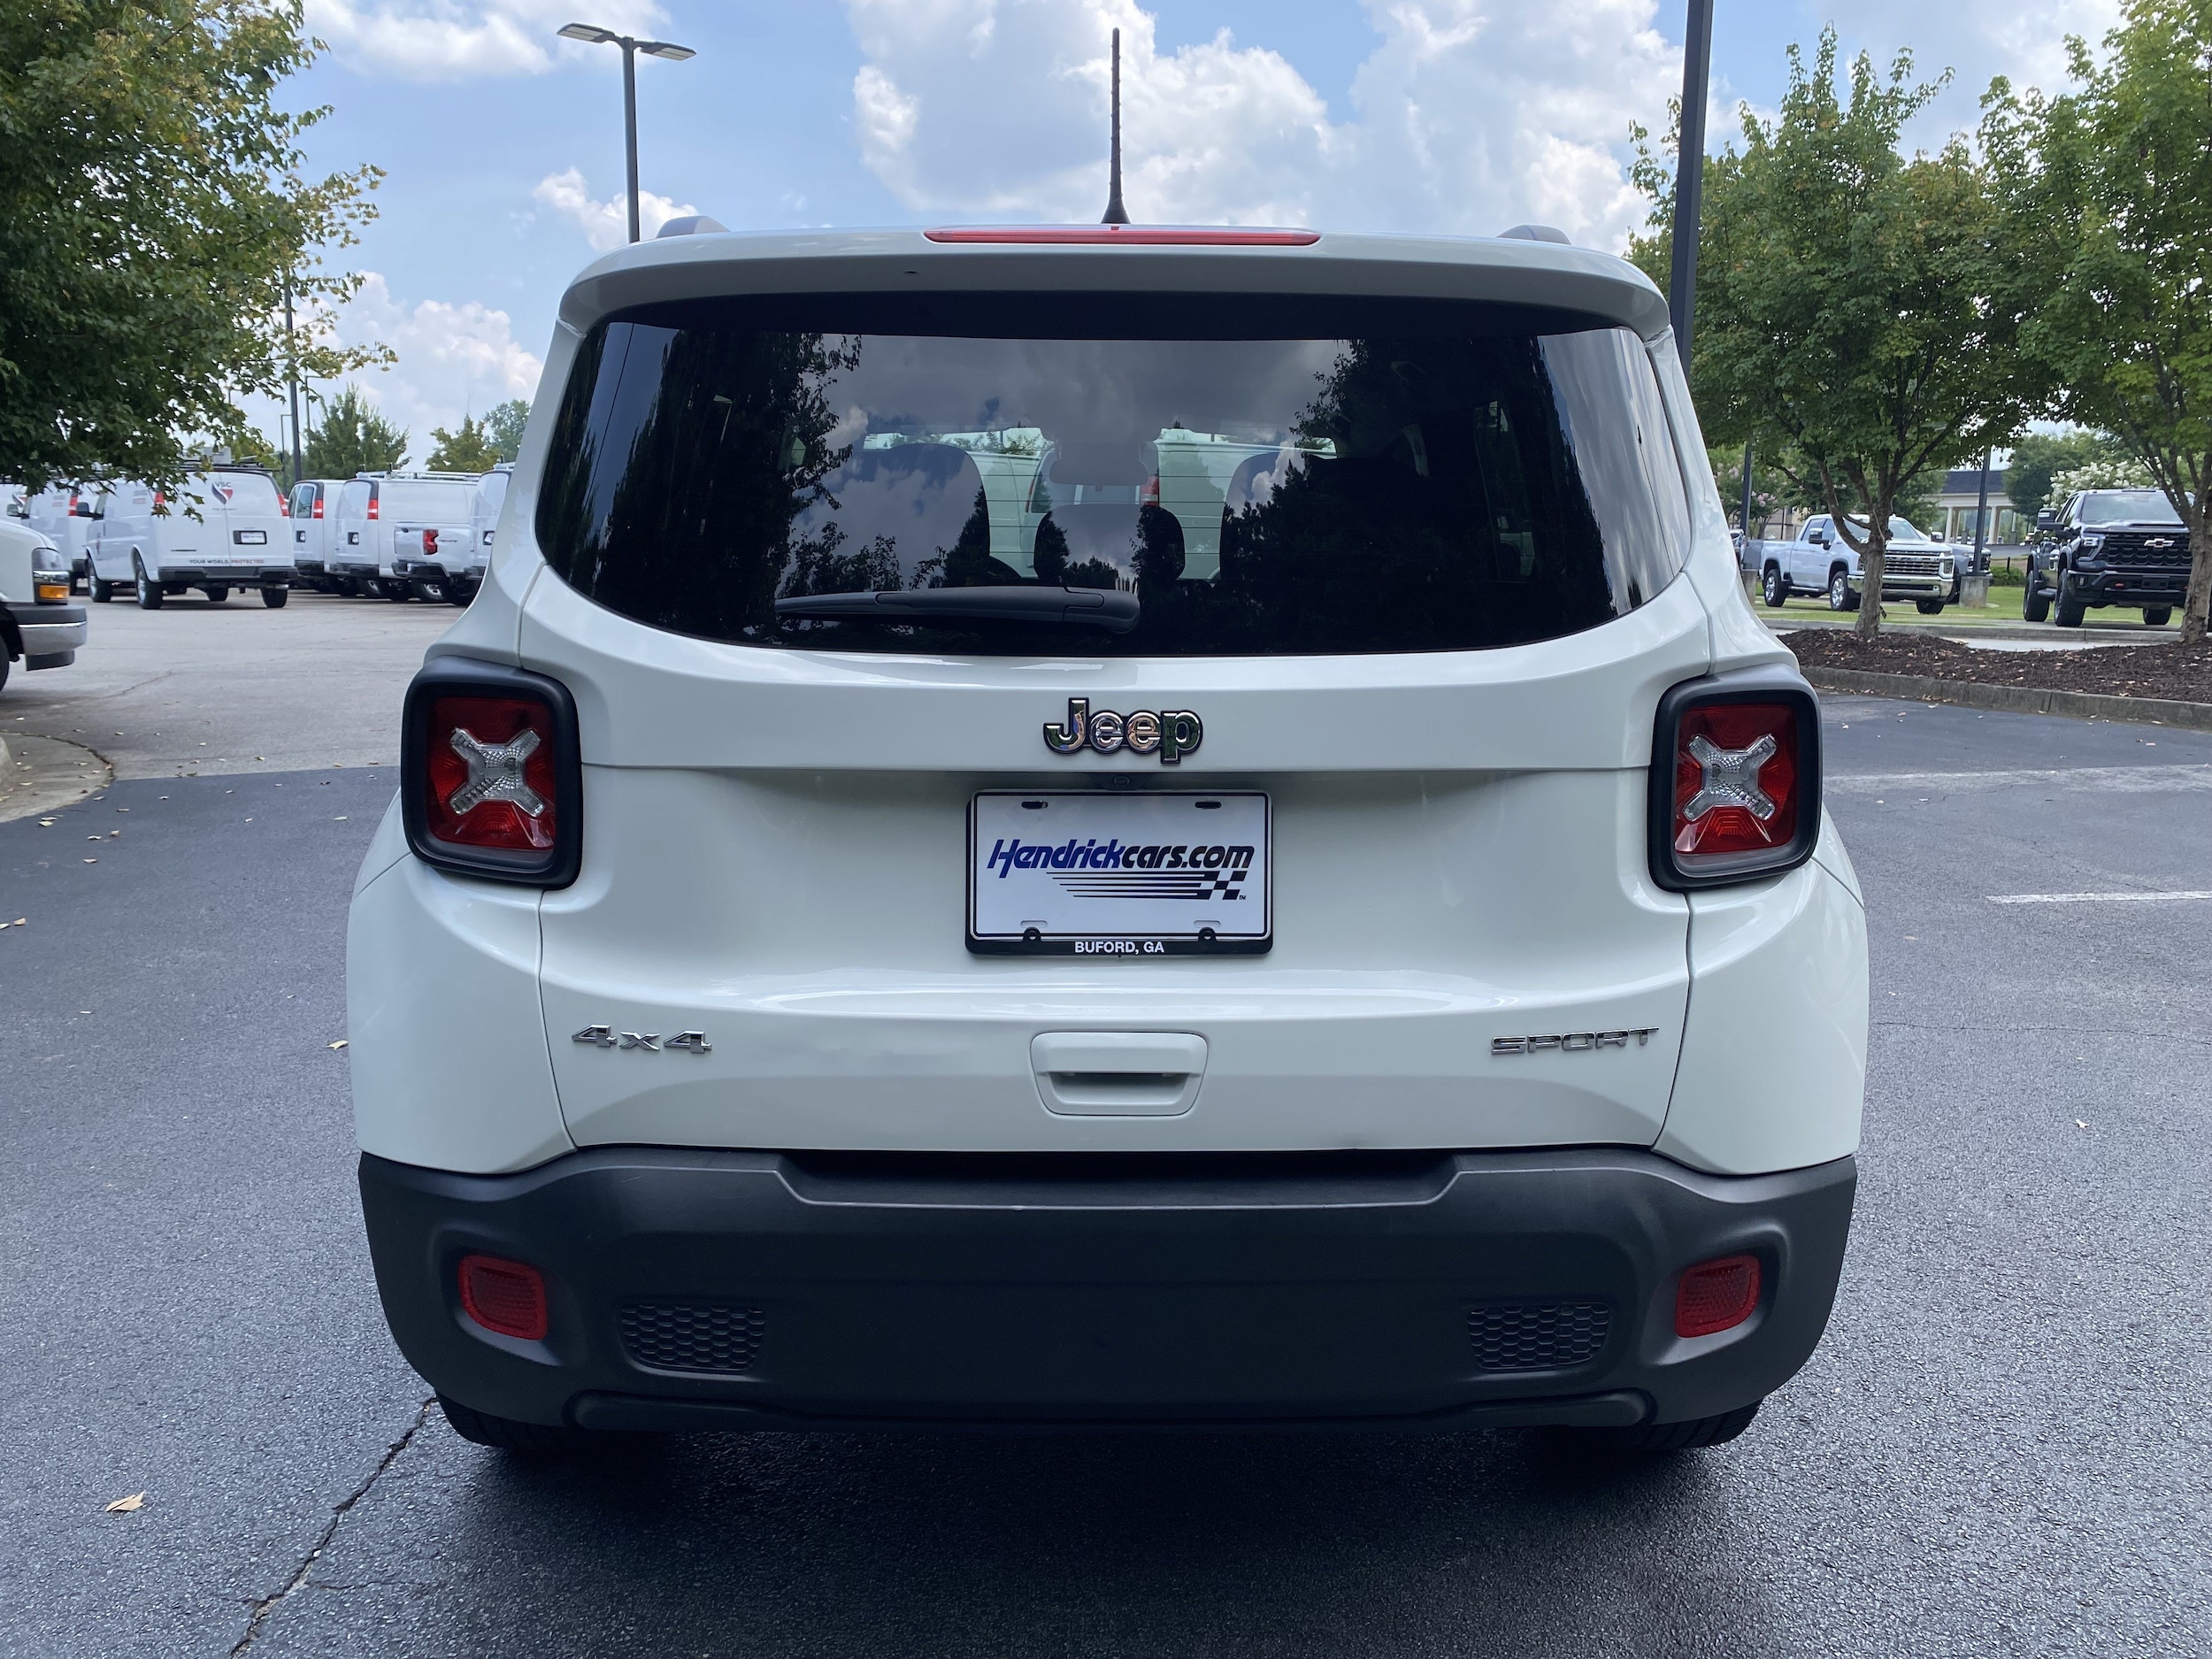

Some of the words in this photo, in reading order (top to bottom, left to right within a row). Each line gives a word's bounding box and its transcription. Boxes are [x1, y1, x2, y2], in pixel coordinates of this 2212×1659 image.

[1043, 697, 1203, 764] Jeep
[987, 839, 1256, 879] Hendrickcars.com
[1074, 941, 1140, 956] BUFORD,
[1143, 941, 1165, 954] GA
[1491, 1026, 1660, 1055] SPORT
